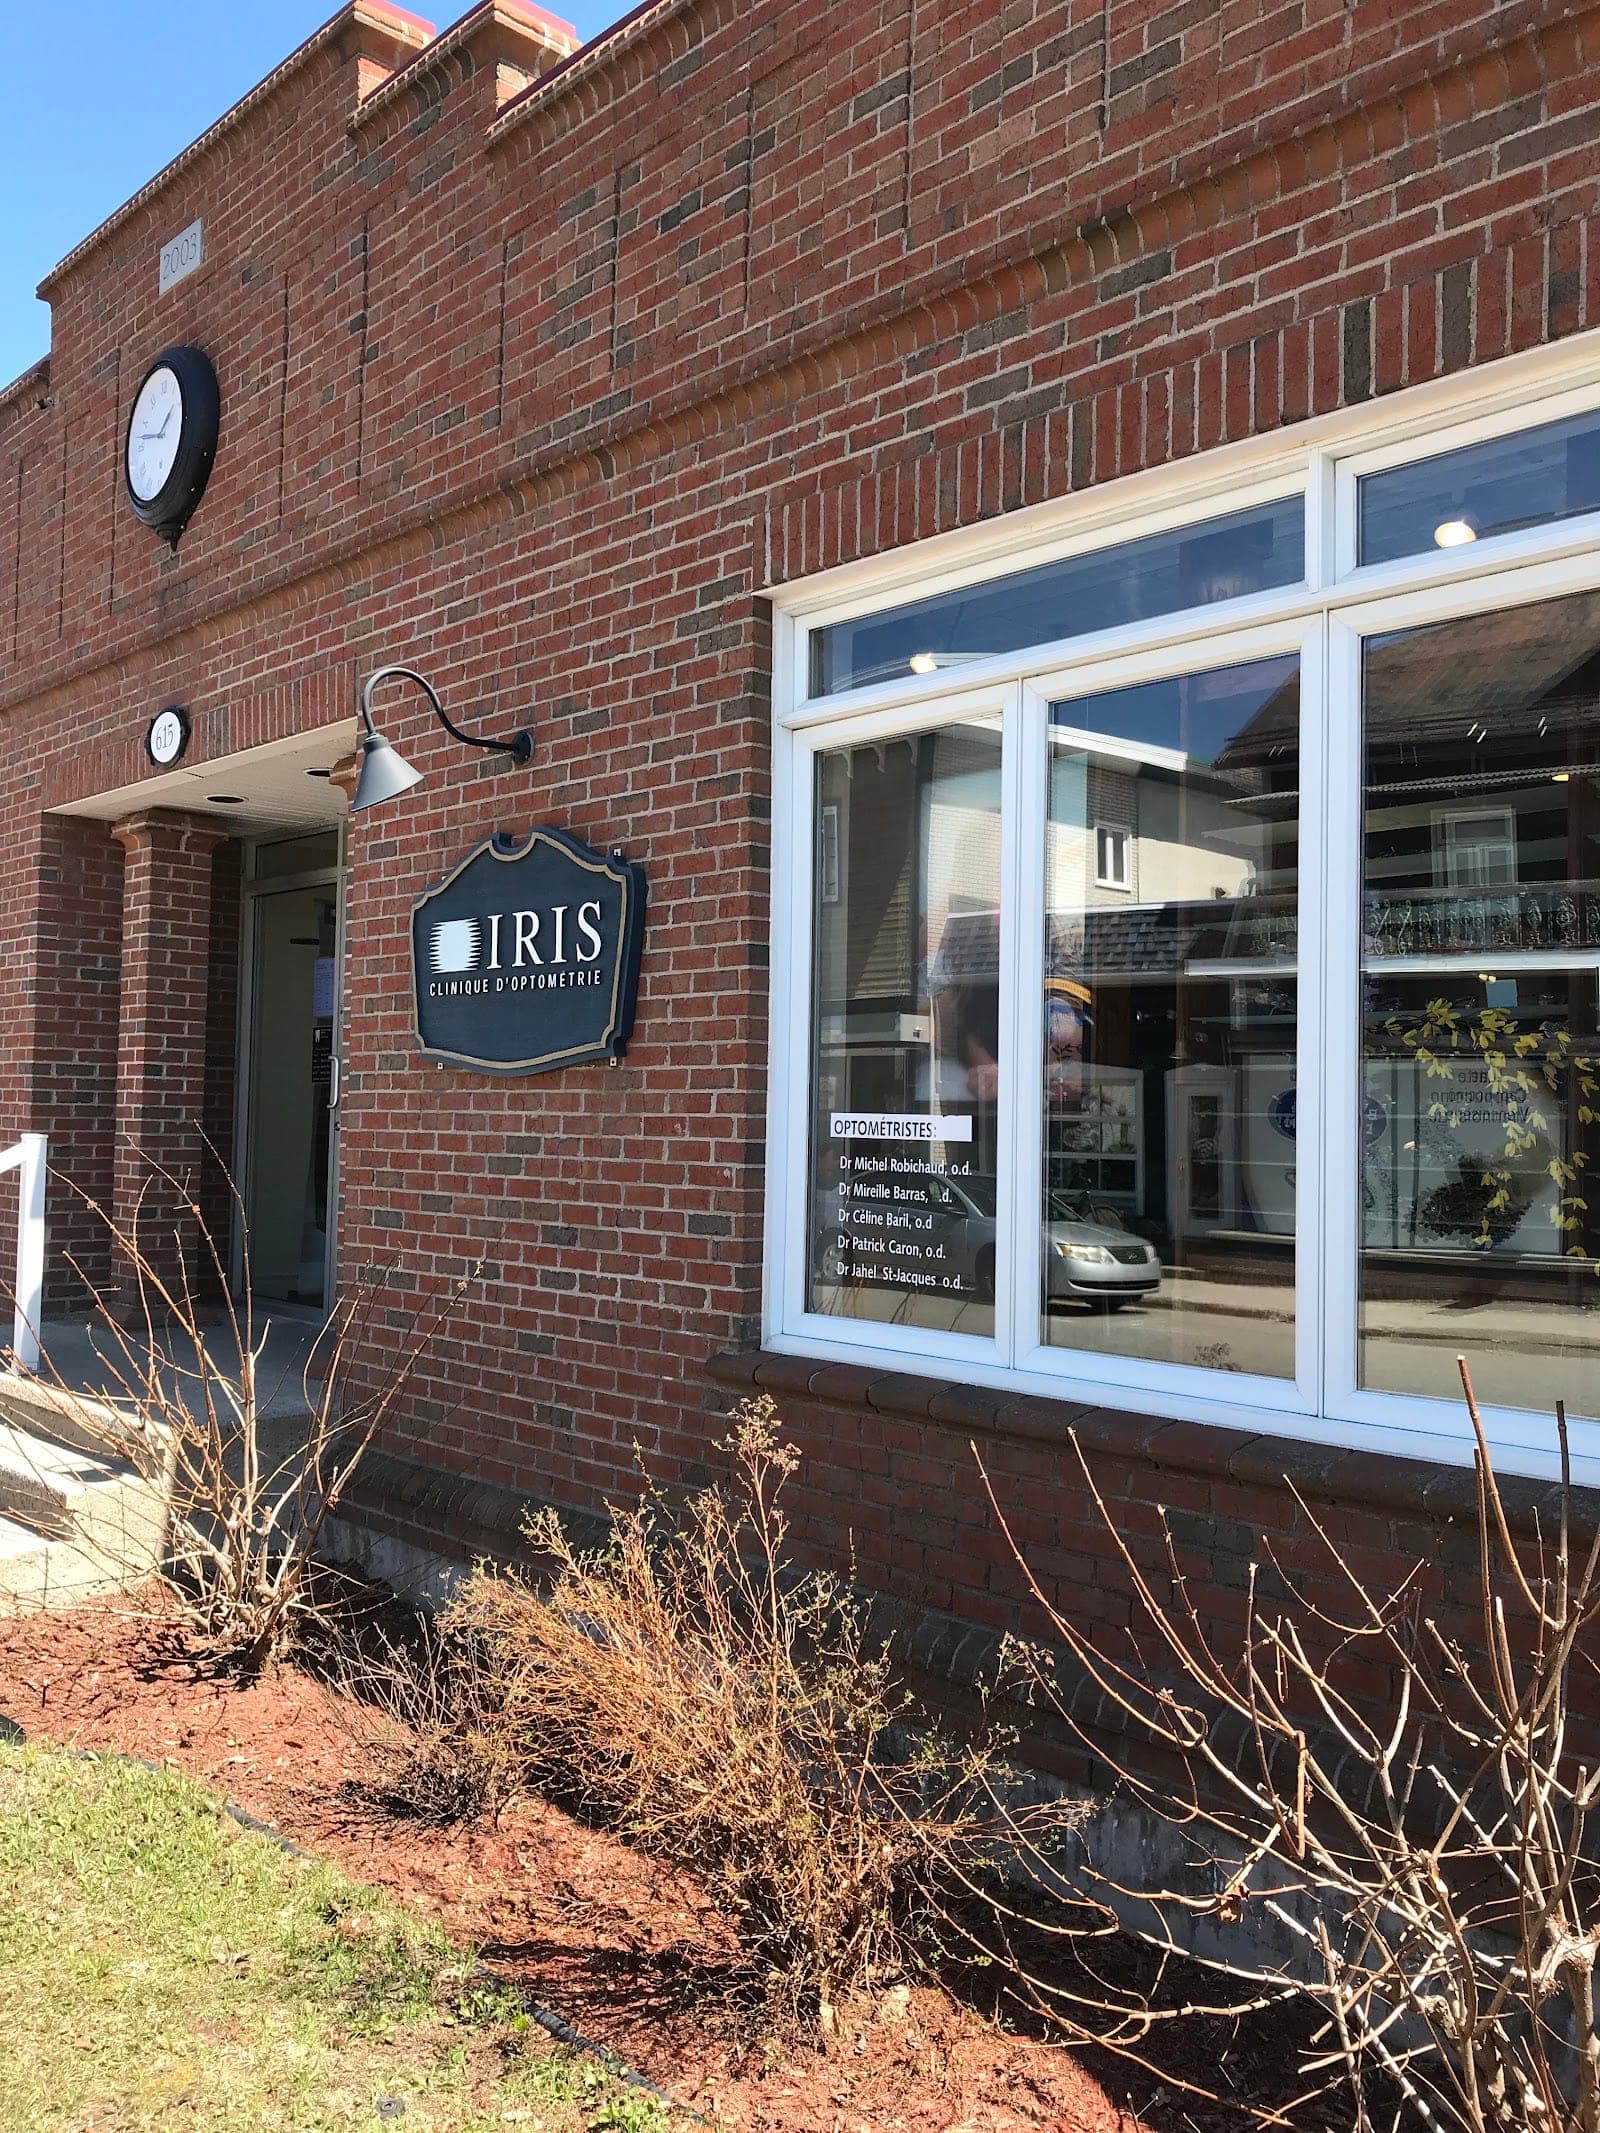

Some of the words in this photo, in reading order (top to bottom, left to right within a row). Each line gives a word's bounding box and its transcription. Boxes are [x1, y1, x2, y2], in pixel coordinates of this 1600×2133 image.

[162, 232, 197, 280] 2003
[155, 723, 174, 751] 615
[486, 900, 602, 970] IRIS
[429, 978, 489, 997] CLINIQUE
[496, 969, 601, 992] D'OPTOMÉTRIE
[840, 1155, 851, 1170] Dr
[854, 1156, 887, 1171] Michel
[890, 1158, 948, 1177] Robichaud,
[951, 1160, 973, 1176] o.d.
[839, 1182, 851, 1197] Dr
[853, 1182, 890, 1199] Mireille
[893, 1185, 929, 1204] Barras,
[838, 1208, 850, 1222] Dr
[853, 1208, 883, 1226] Céline
[886, 1212, 912, 1230] Baril,
[915, 1214, 933, 1230] o.d
[837, 1234, 850, 1249] Dr
[852, 1236, 886, 1253] Patrick
[888, 1239, 923, 1259] Caron,
[925, 1243, 947, 1259] o.d.
[837, 1261, 849, 1275] Dr
[851, 1263, 877, 1279] Jahel
[882, 1266, 937, 1287] St-Jacques
[942, 1274, 964, 1290] o.d.
